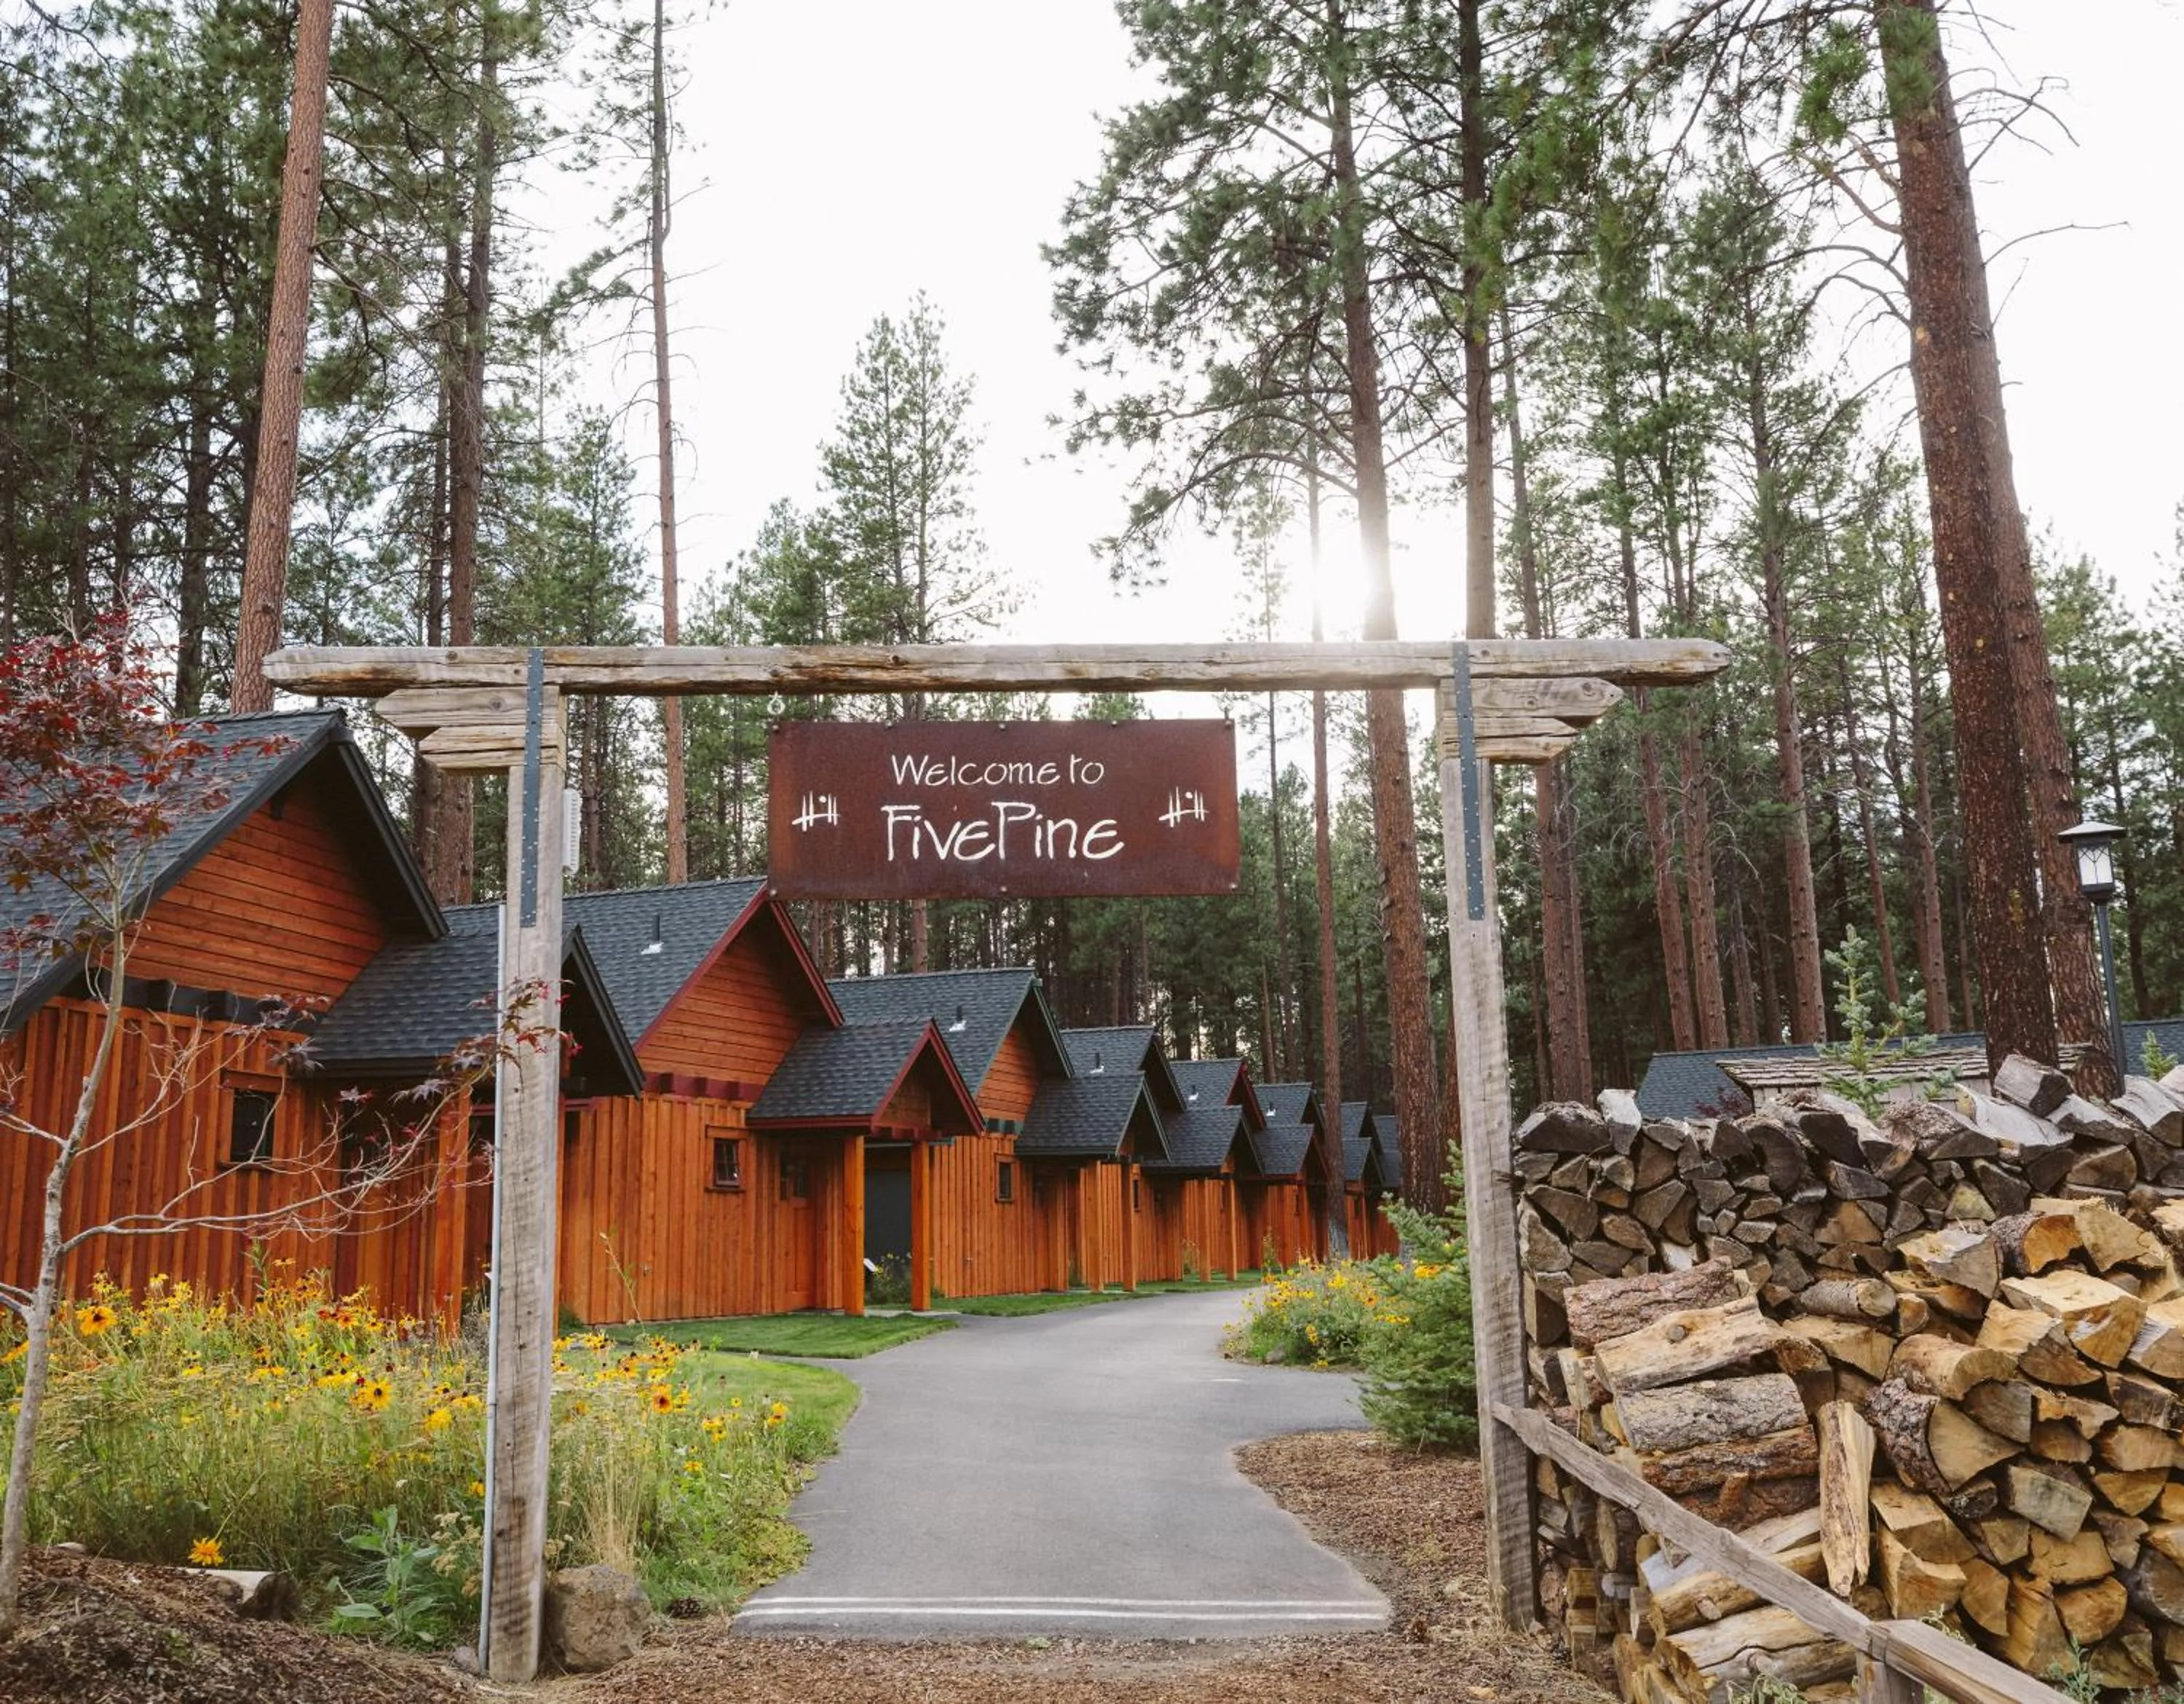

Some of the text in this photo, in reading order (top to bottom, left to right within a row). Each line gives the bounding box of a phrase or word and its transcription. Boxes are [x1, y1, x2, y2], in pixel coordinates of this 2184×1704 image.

[891, 753, 1105, 786] Welcome to
[880, 801, 1125, 861] FivePine
